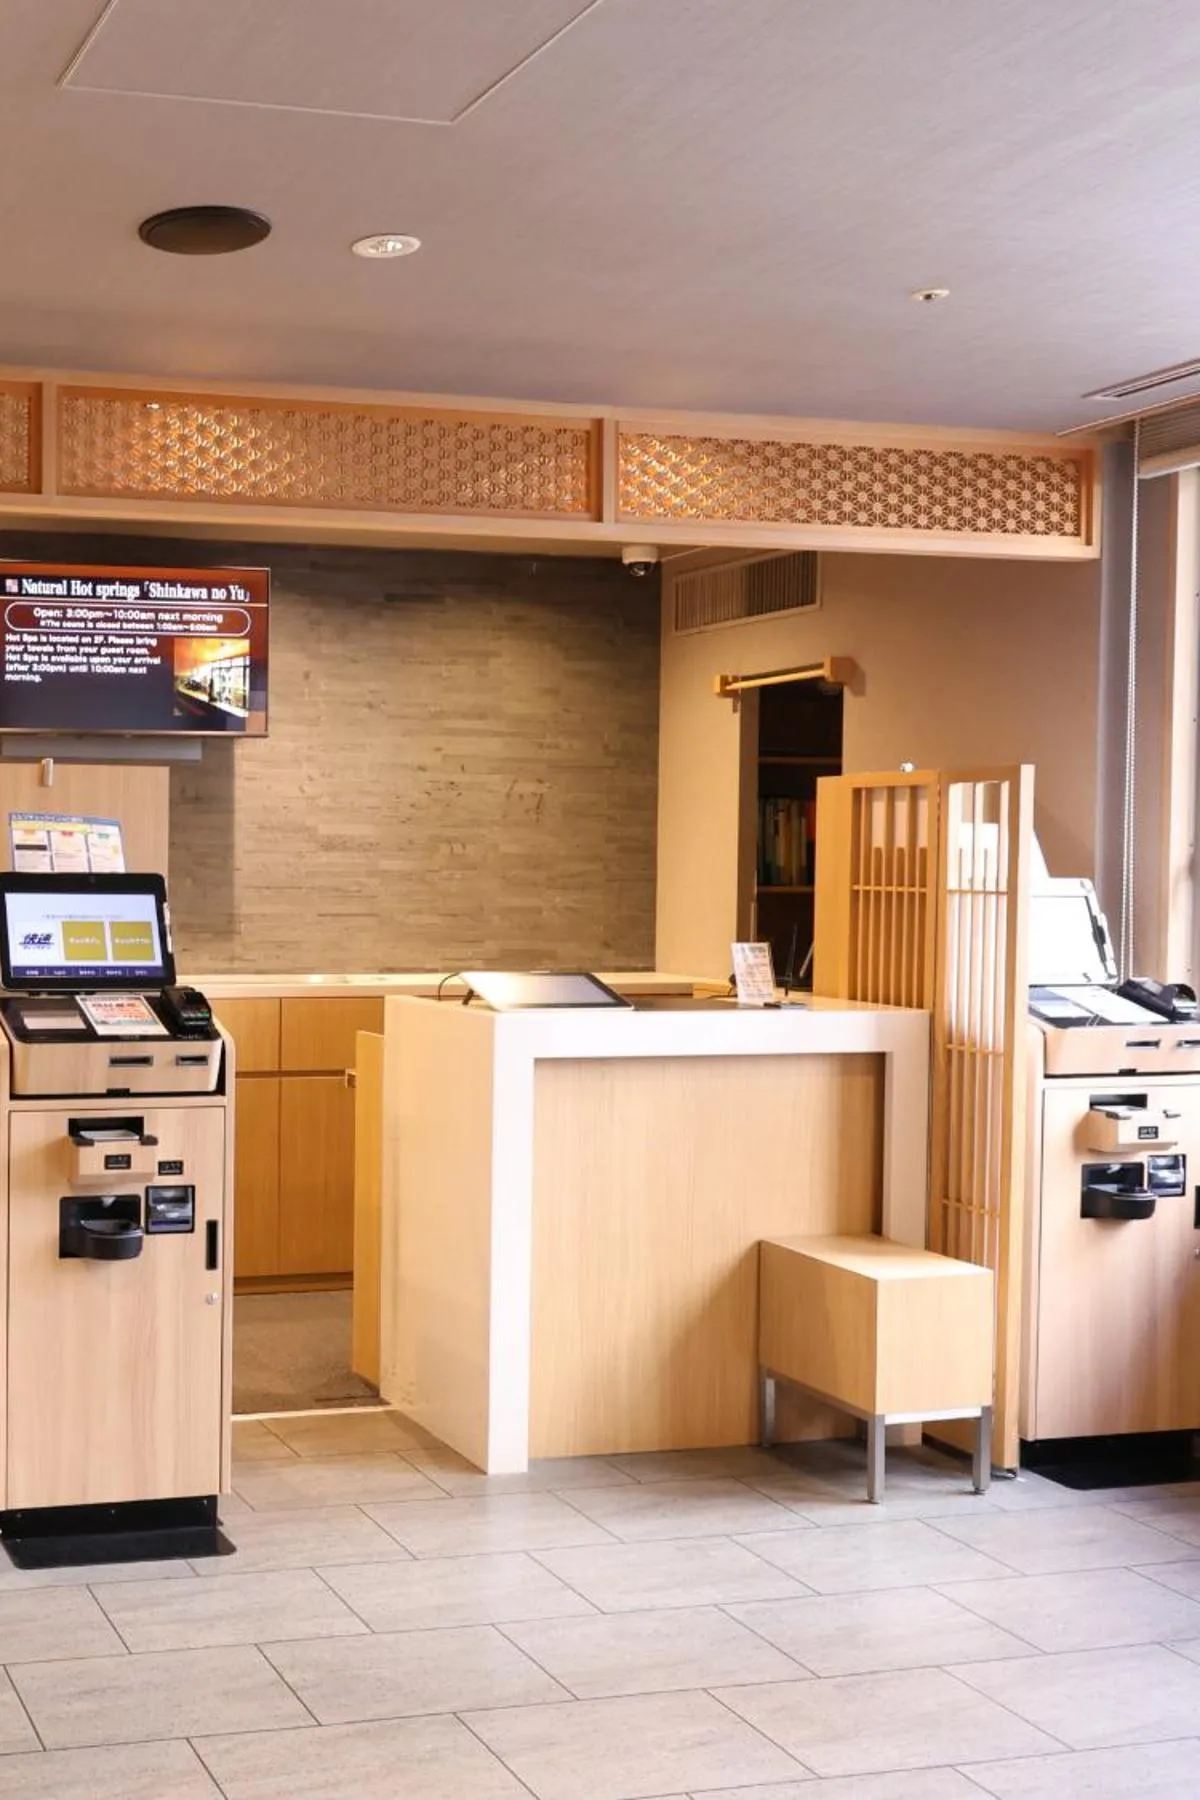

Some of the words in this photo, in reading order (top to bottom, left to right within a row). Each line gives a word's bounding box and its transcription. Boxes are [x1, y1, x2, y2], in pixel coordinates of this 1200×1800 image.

[22, 578, 67, 596] Natural
[70, 580, 93, 596] Hot
[96, 581, 140, 601] springs
[211, 588, 227, 600] no
[33, 607, 63, 619] Open:
[158, 612, 180, 621] next
[182, 612, 223, 624] morning
[95, 622, 120, 630] closed
[122, 622, 154, 630] between
[5, 633, 20, 642] Hot
[22, 634, 38, 643] Spa
[49, 635, 79, 643] located
[108, 635, 135, 645] Please
[136, 637, 157, 647] bring
[56, 645, 77, 653] from
[79, 646, 99, 656] your
[100, 647, 124, 655] guest
[5, 653, 20, 661] Hot
[22, 653, 39, 662] Spa
[50, 654, 87, 663] available
[113, 657, 132, 665] your
[134, 655, 161, 665] arrival
[5, 674, 42, 683] morning.
